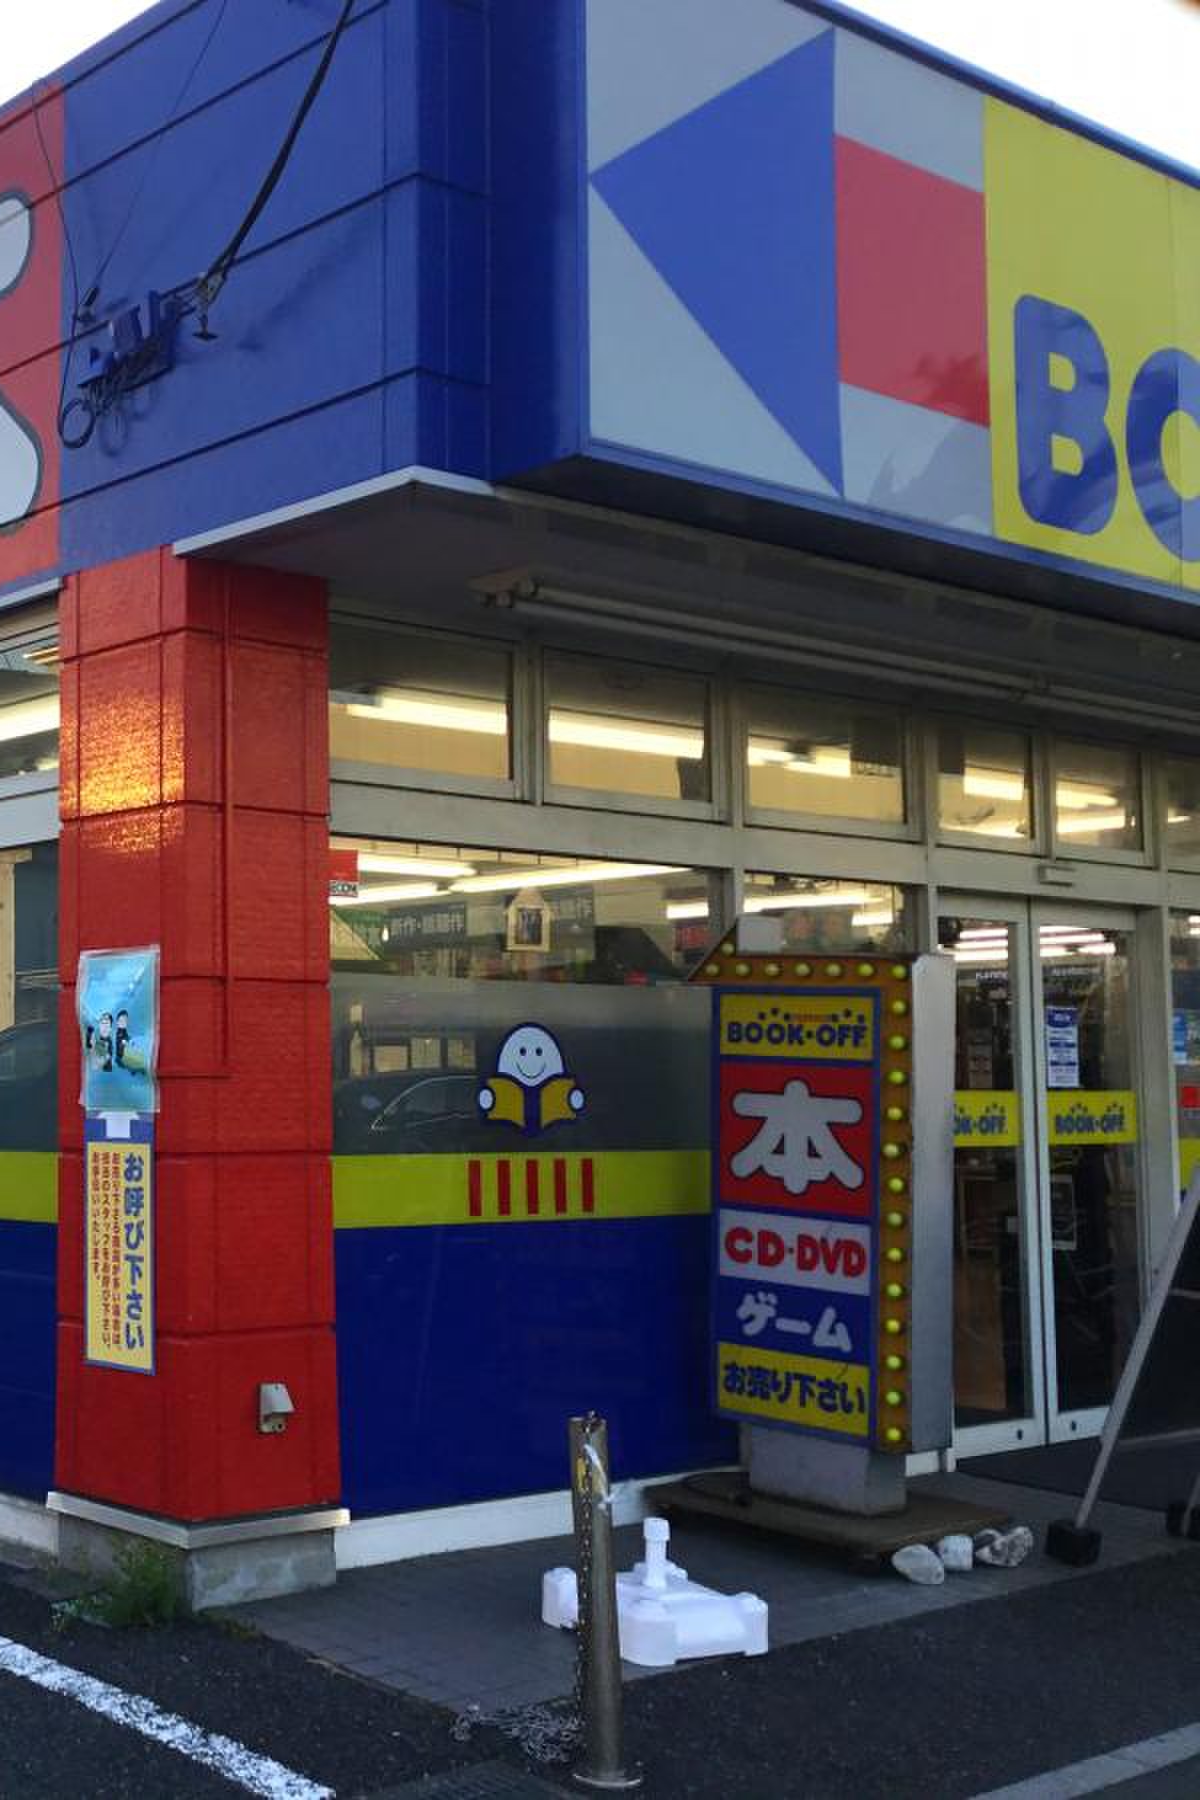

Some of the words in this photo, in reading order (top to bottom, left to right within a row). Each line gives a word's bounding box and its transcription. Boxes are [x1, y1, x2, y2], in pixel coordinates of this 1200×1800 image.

[731, 1079, 865, 1195] 本
[124, 1152, 144, 1349] お呼び下さい
[737, 1291, 852, 1352] ゲーム
[723, 1361, 866, 1415] お売り下さい
